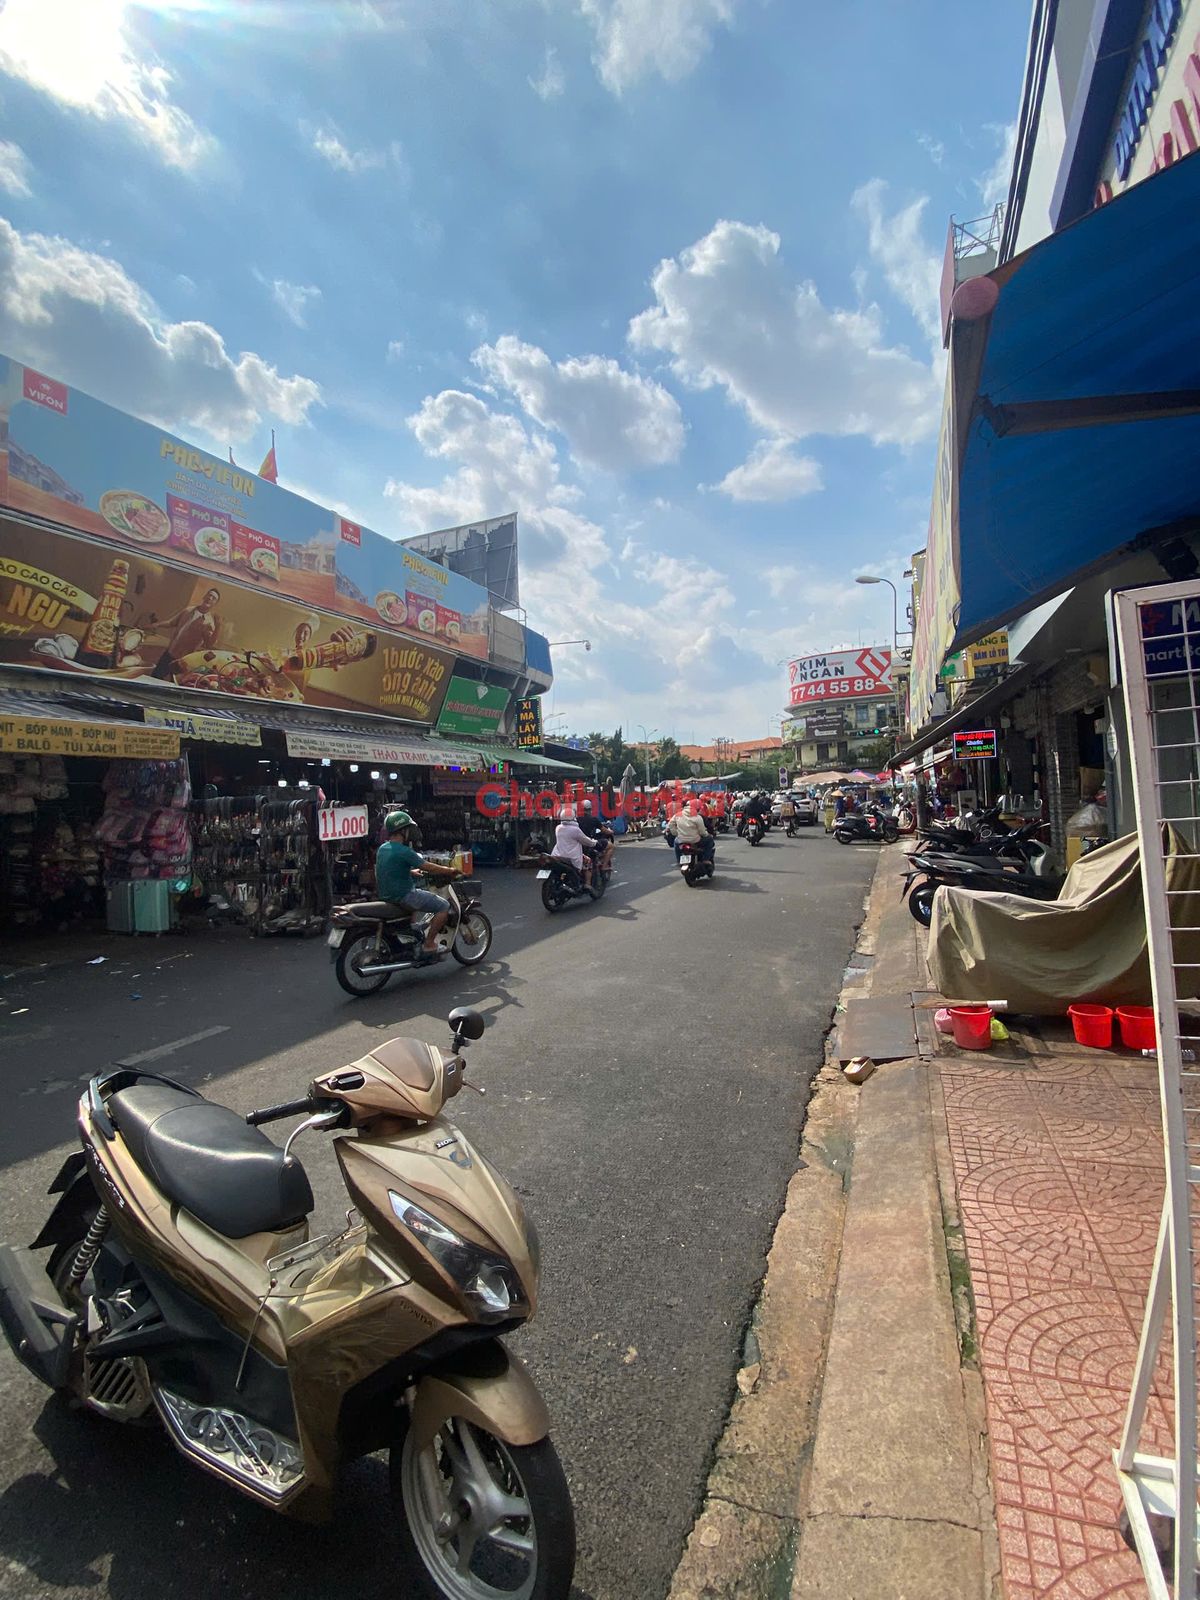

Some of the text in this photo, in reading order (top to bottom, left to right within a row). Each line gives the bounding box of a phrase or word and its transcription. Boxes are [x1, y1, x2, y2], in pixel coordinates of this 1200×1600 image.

[28, 387, 65, 410] VIFON
[20, 568, 50, 586] CAO
[799, 657, 828, 672] KIM
[25, 723, 48, 736] BÓP
[86, 740, 118, 755] XÁCH
[321, 809, 367, 839] 11.000
